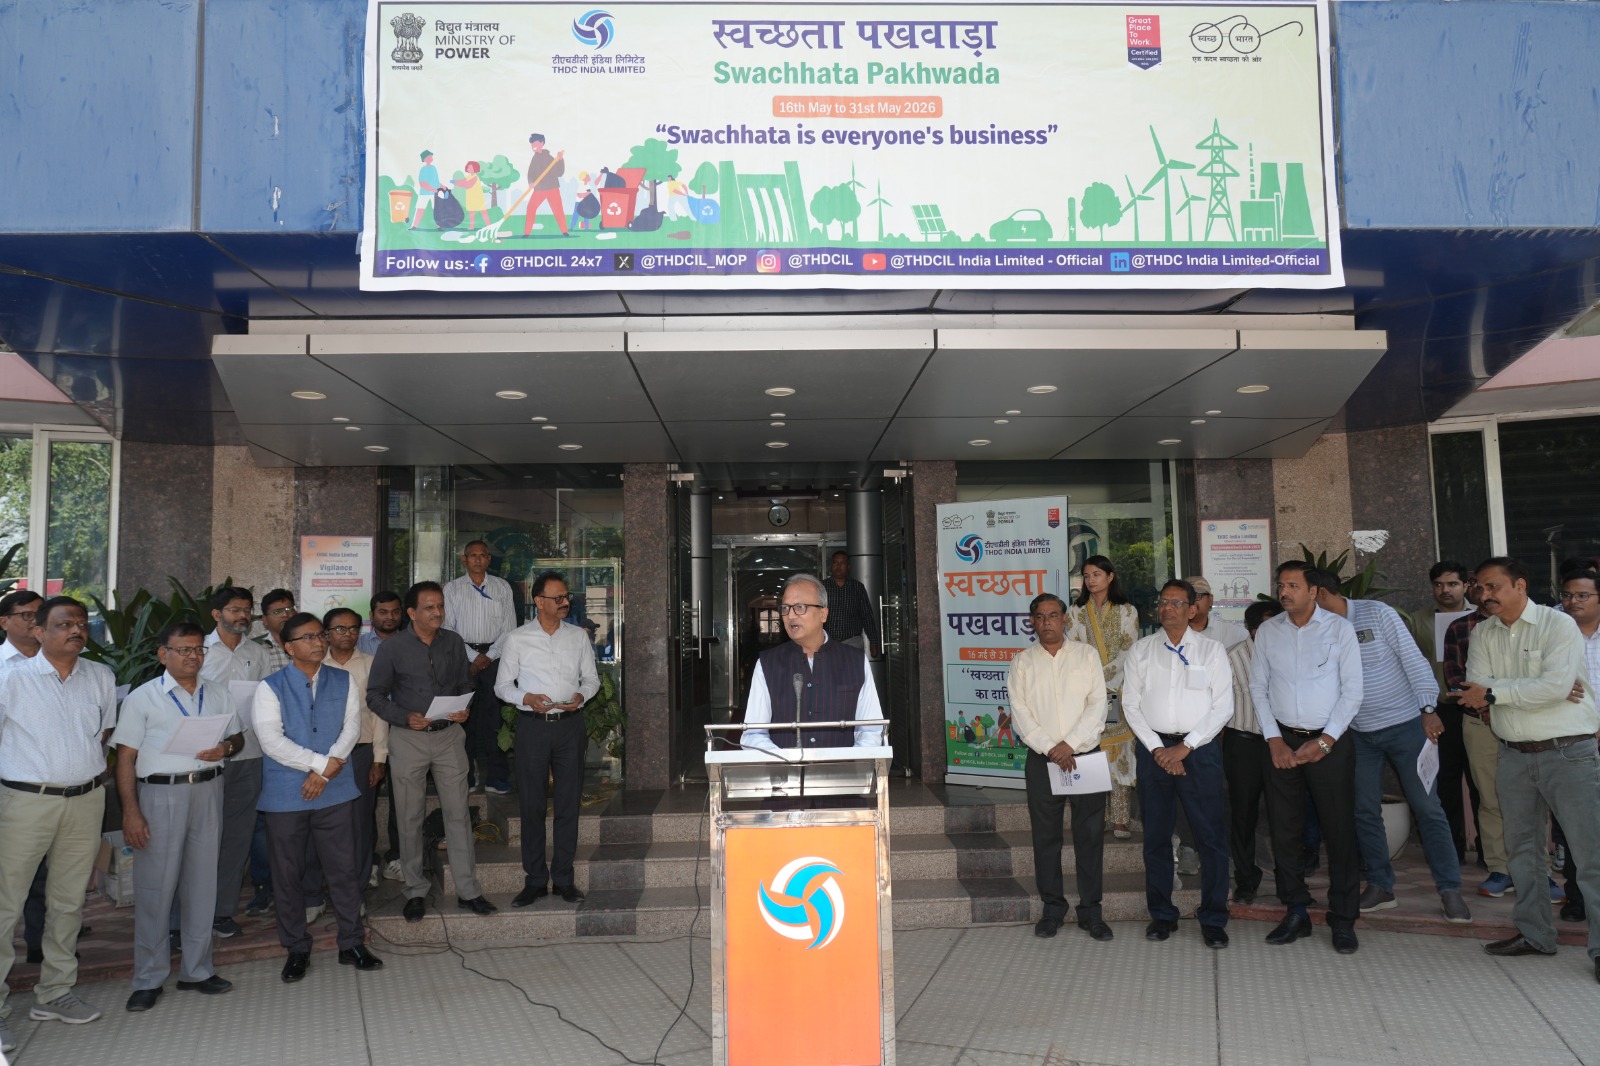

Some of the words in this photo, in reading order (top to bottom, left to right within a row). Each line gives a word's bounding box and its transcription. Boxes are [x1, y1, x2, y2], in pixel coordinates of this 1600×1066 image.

[435, 20, 462, 34] विद्युत
[465, 21, 500, 31] मंत्रालय
[435, 35, 495, 45] MINISTRY
[499, 35, 516, 45] OF
[712, 20, 845, 49] स्वच्छता
[856, 20, 998, 57] पखवाड़ा
[435, 48, 490, 59] POWER
[552, 54, 588, 64] टीएचडीसी
[591, 54, 612, 65] इंडिया
[615, 54, 645, 64] लिमिटेड
[552, 66, 578, 74] THDC
[580, 66, 606, 74] INDIA
[609, 66, 645, 74] LIMITED
[714, 61, 859, 85] Swachhata
[867, 61, 1000, 85] Pakhwada
[779, 101, 805, 113] 16th
[808, 102, 832, 115] May
[834, 103, 846, 114] to
[849, 102, 875, 114] 31st
[878, 102, 901, 116] May
[904, 101, 936, 113] 2026
[655, 123, 791, 145] “Swachhata
[797, 123, 816, 145] is
[821, 125, 944, 150] everyone's
[950, 123, 1058, 145] business”
[386, 256, 439, 270] Follow
[500, 256, 567, 271] @THDCIL
[571, 255, 603, 267] 24x7
[641, 254, 747, 269] @THDCIL_MOP
[788, 254, 854, 269] @THDCIL
[890, 254, 955, 269] @THDCIL
[959, 254, 991, 266] India
[995, 254, 1044, 266] Limited
[1056, 254, 1103, 266] Official
[1131, 254, 1183, 269] @THDC
[1187, 254, 1218, 266] India
[1223, 254, 1320, 266] Limited-Official
[320, 563, 353, 572] Vigilance
[944, 569, 1047, 598] स्वच्छता
[978, 649, 988, 659] मई
[999, 651, 1007, 659] 31
[975, 689, 989, 699] का
